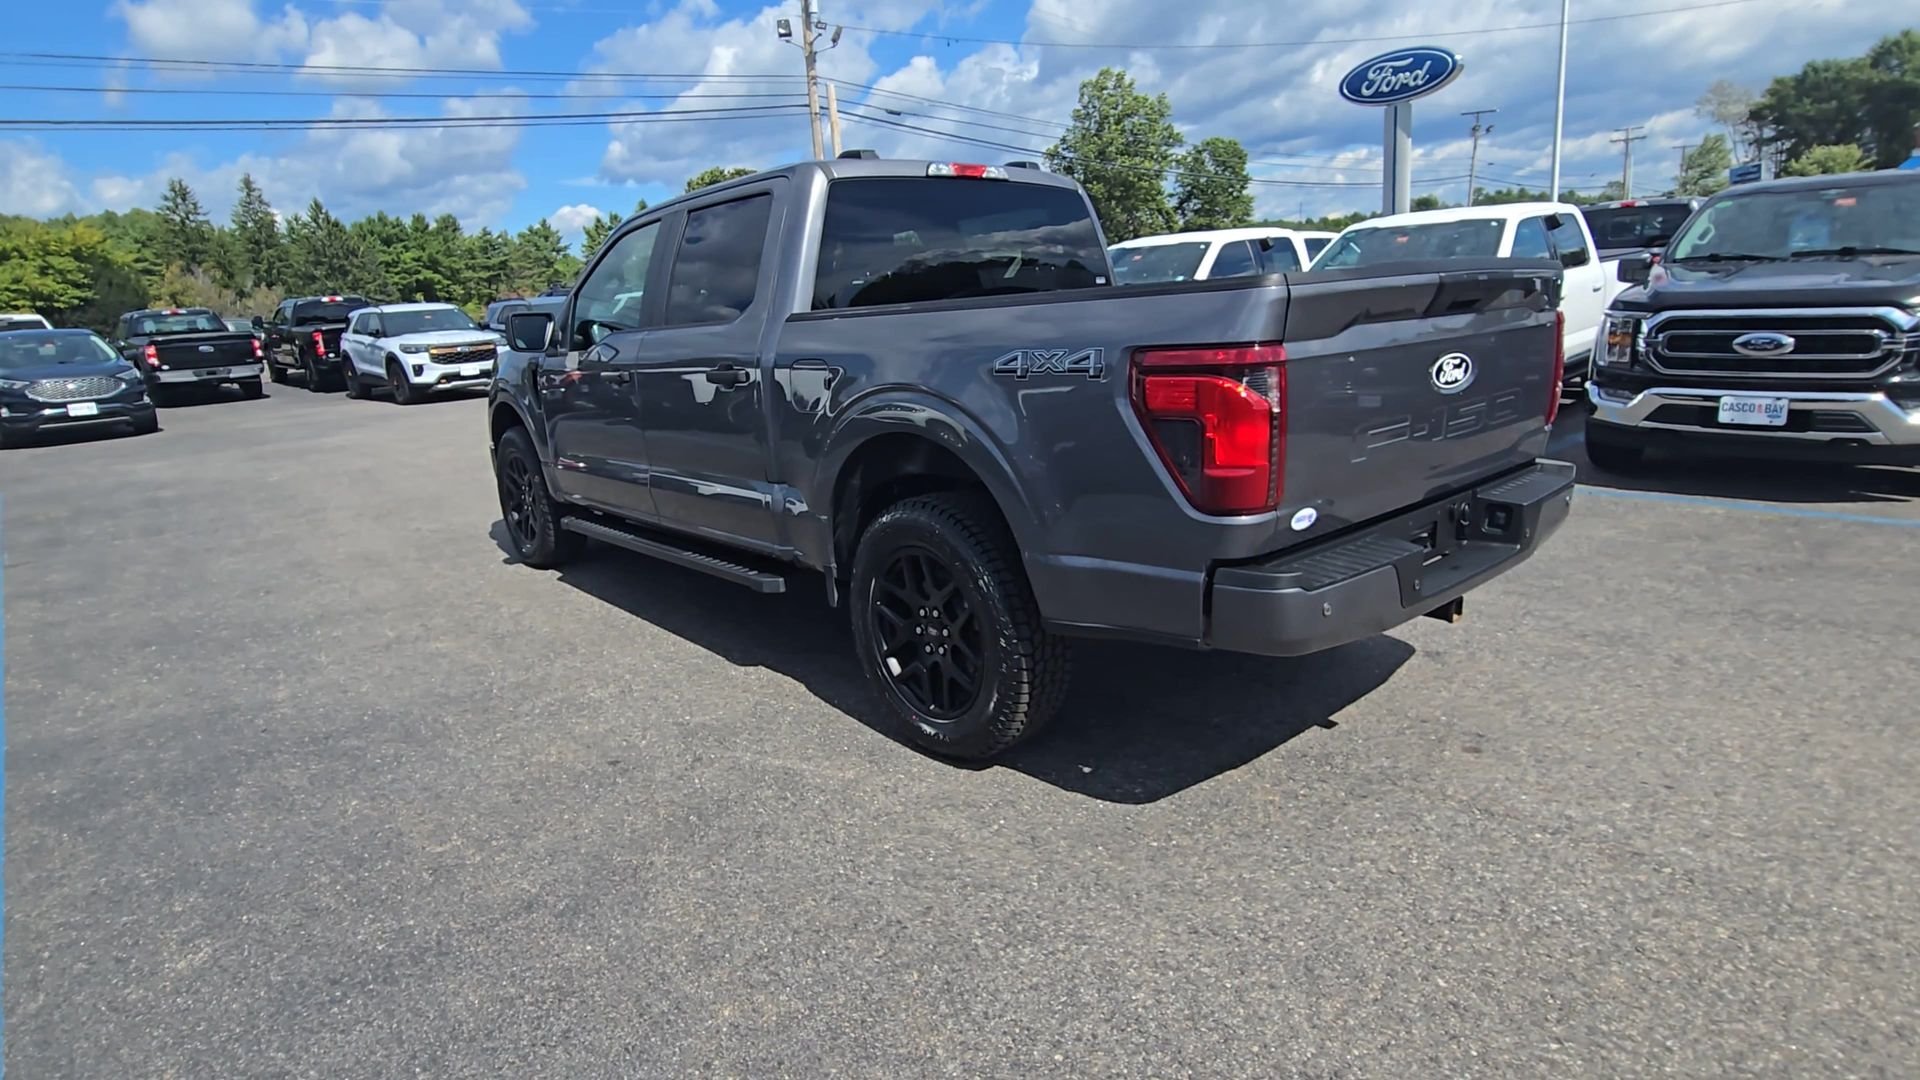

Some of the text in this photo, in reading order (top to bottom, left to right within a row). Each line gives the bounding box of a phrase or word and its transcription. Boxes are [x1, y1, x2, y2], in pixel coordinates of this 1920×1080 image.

[1361, 57, 1432, 97] Ford
[1439, 358, 1467, 384] Ford
[1721, 402, 1786, 414] CASCO BAY
